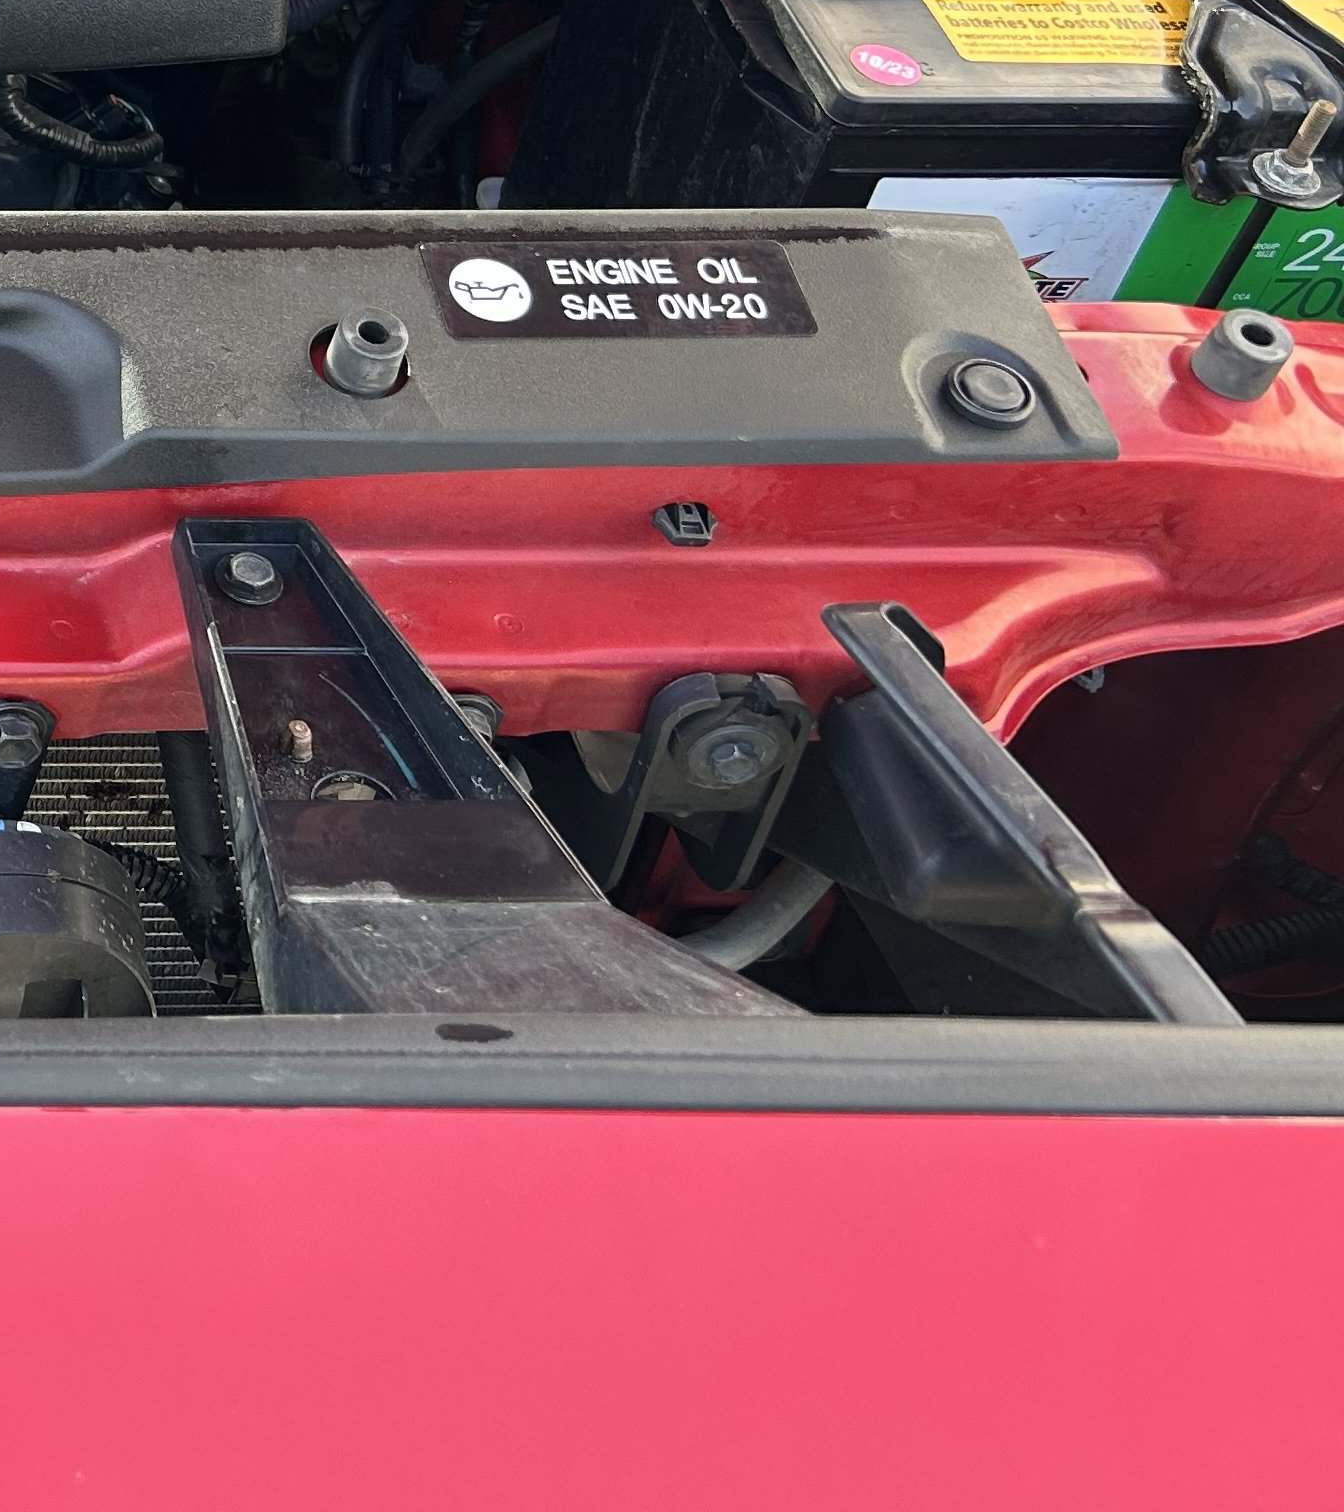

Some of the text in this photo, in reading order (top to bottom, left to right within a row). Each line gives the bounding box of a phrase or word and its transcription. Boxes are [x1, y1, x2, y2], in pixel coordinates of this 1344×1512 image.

[1000, 0, 1082, 16] warranty
[1087, 0, 1121, 14] and
[1123, 0, 1164, 14] used
[949, 15, 1189, 32] batteries to Costco Wholesa
[857, 51, 916, 79] 10/23
[545, 257, 758, 285] ENGINE OIL
[561, 292, 768, 321] SAE 0W-20
